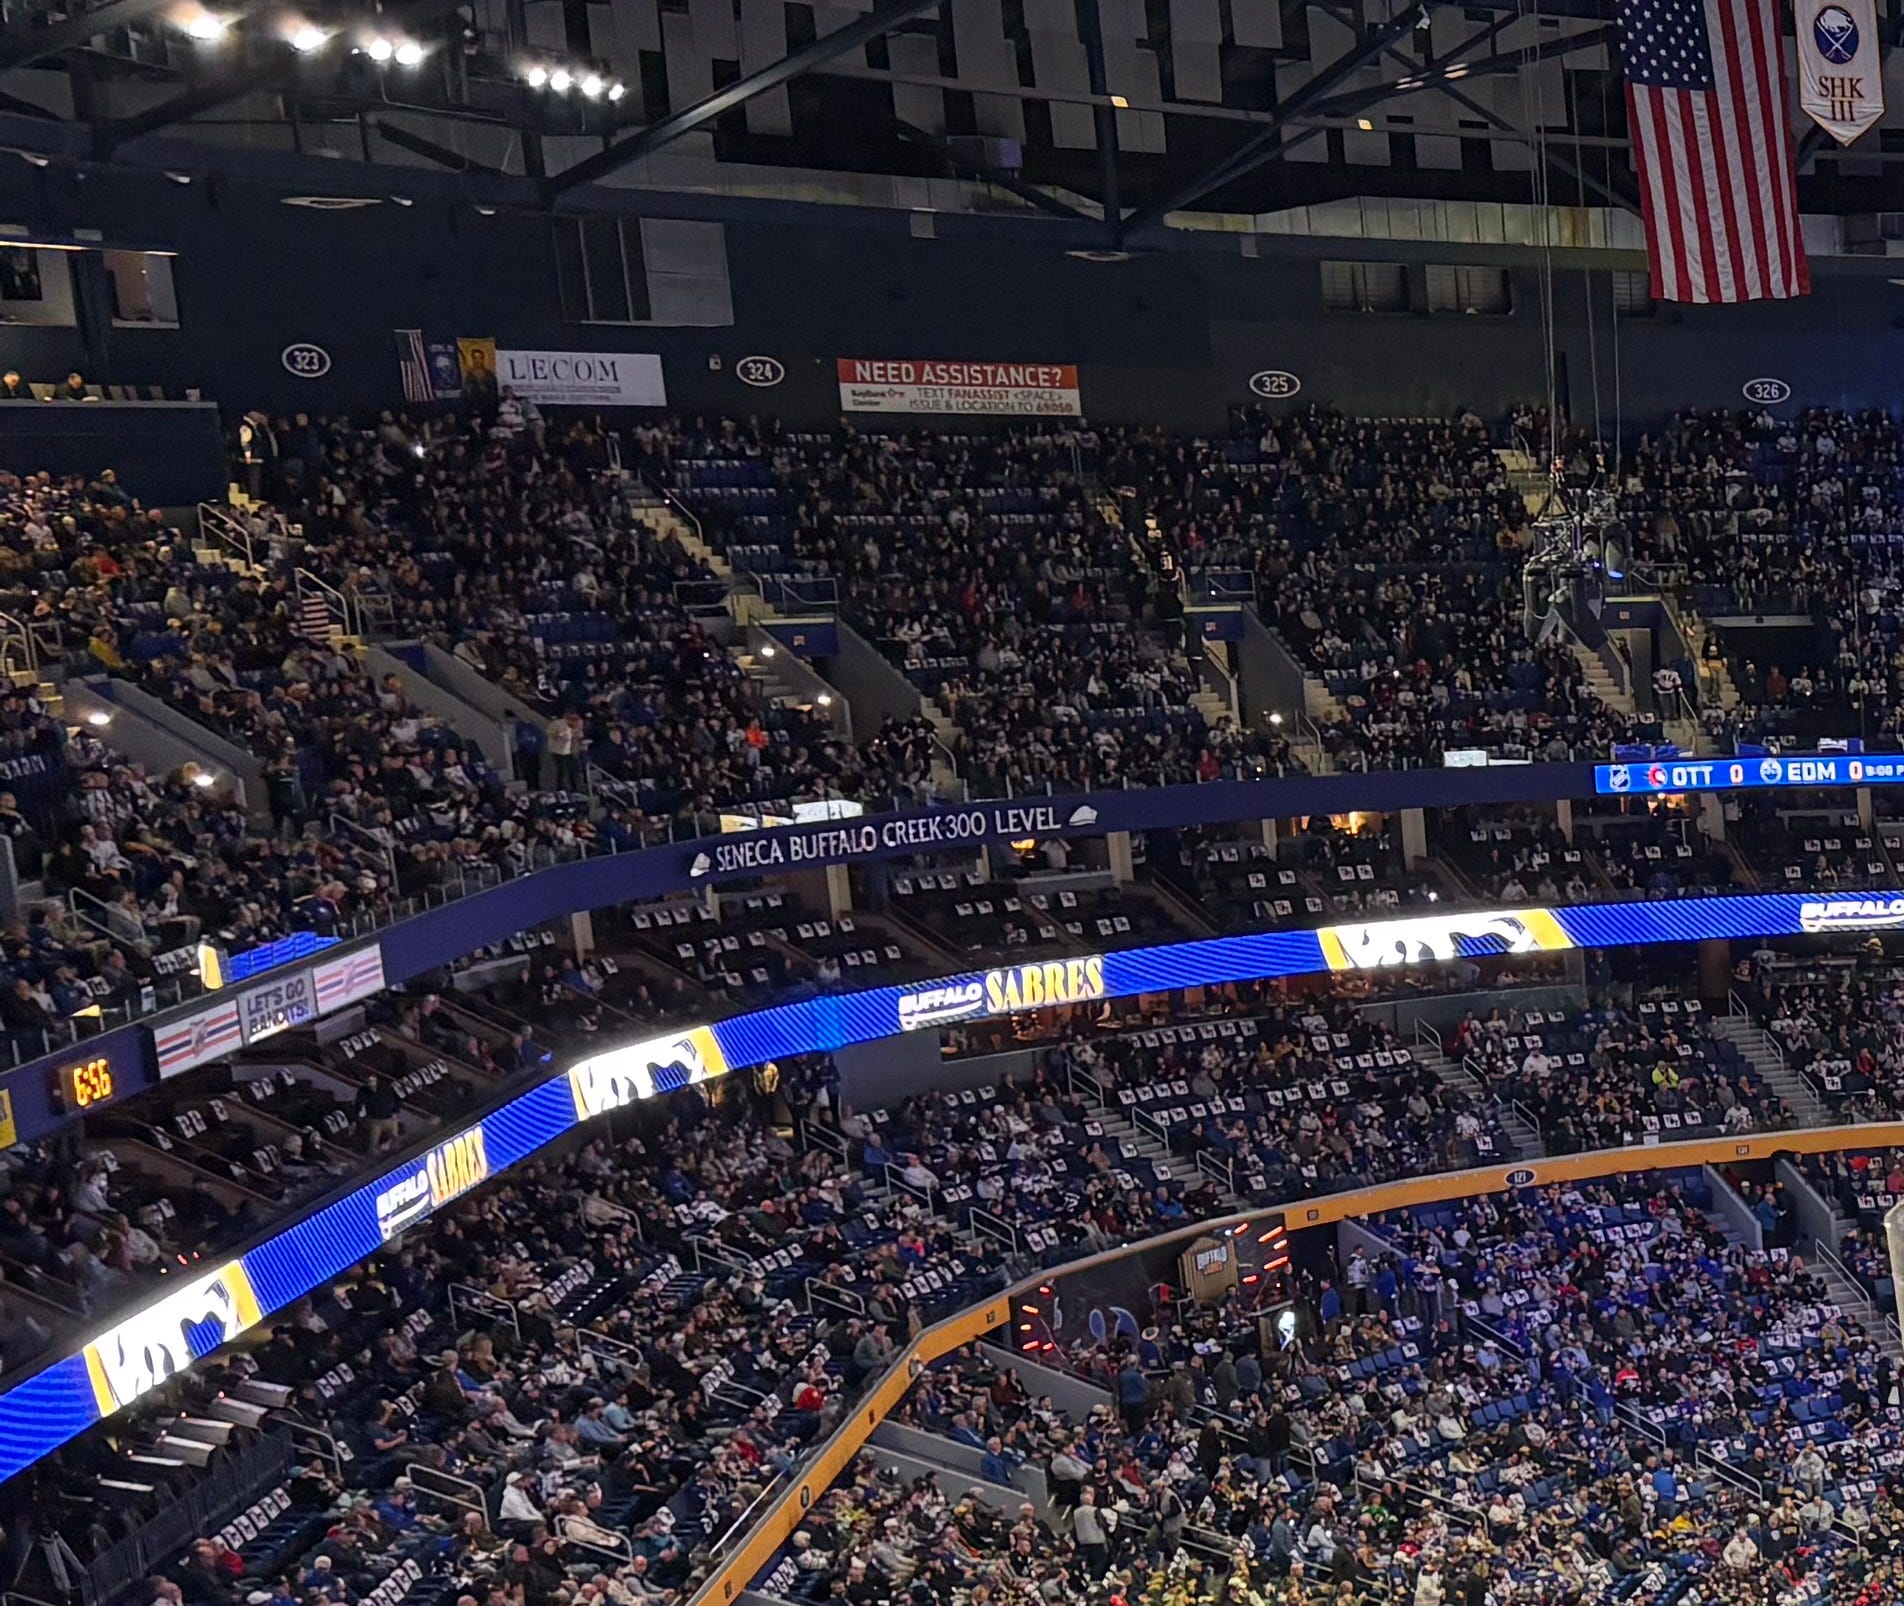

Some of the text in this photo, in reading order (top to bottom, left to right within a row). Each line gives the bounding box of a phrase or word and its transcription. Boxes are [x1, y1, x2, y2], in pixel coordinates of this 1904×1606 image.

[1818, 76, 1865, 98] SHK
[293, 351, 320, 371] 323
[508, 358, 619, 382] LECOM
[746, 362, 774, 380] 324
[855, 361, 1062, 387] NEED ASSISTANCE?
[1261, 376, 1289, 391] 325
[948, 389, 1009, 399] FANASSIST
[1754, 383, 1780, 399] 326
[960, 402, 1015, 411] LOCATION
[1672, 764, 1744, 786] OTT 0
[1787, 762, 1864, 781] EDM 0
[716, 806, 1061, 872] SENECA BUFFALO CREEK 300 LEVEL
[899, 958, 1104, 1013] BUFFALO SABRES
[248, 978, 305, 1016] LET'S GO
[73, 1058, 112, 1106] 6:56
[427, 1125, 489, 1208] SABRES
